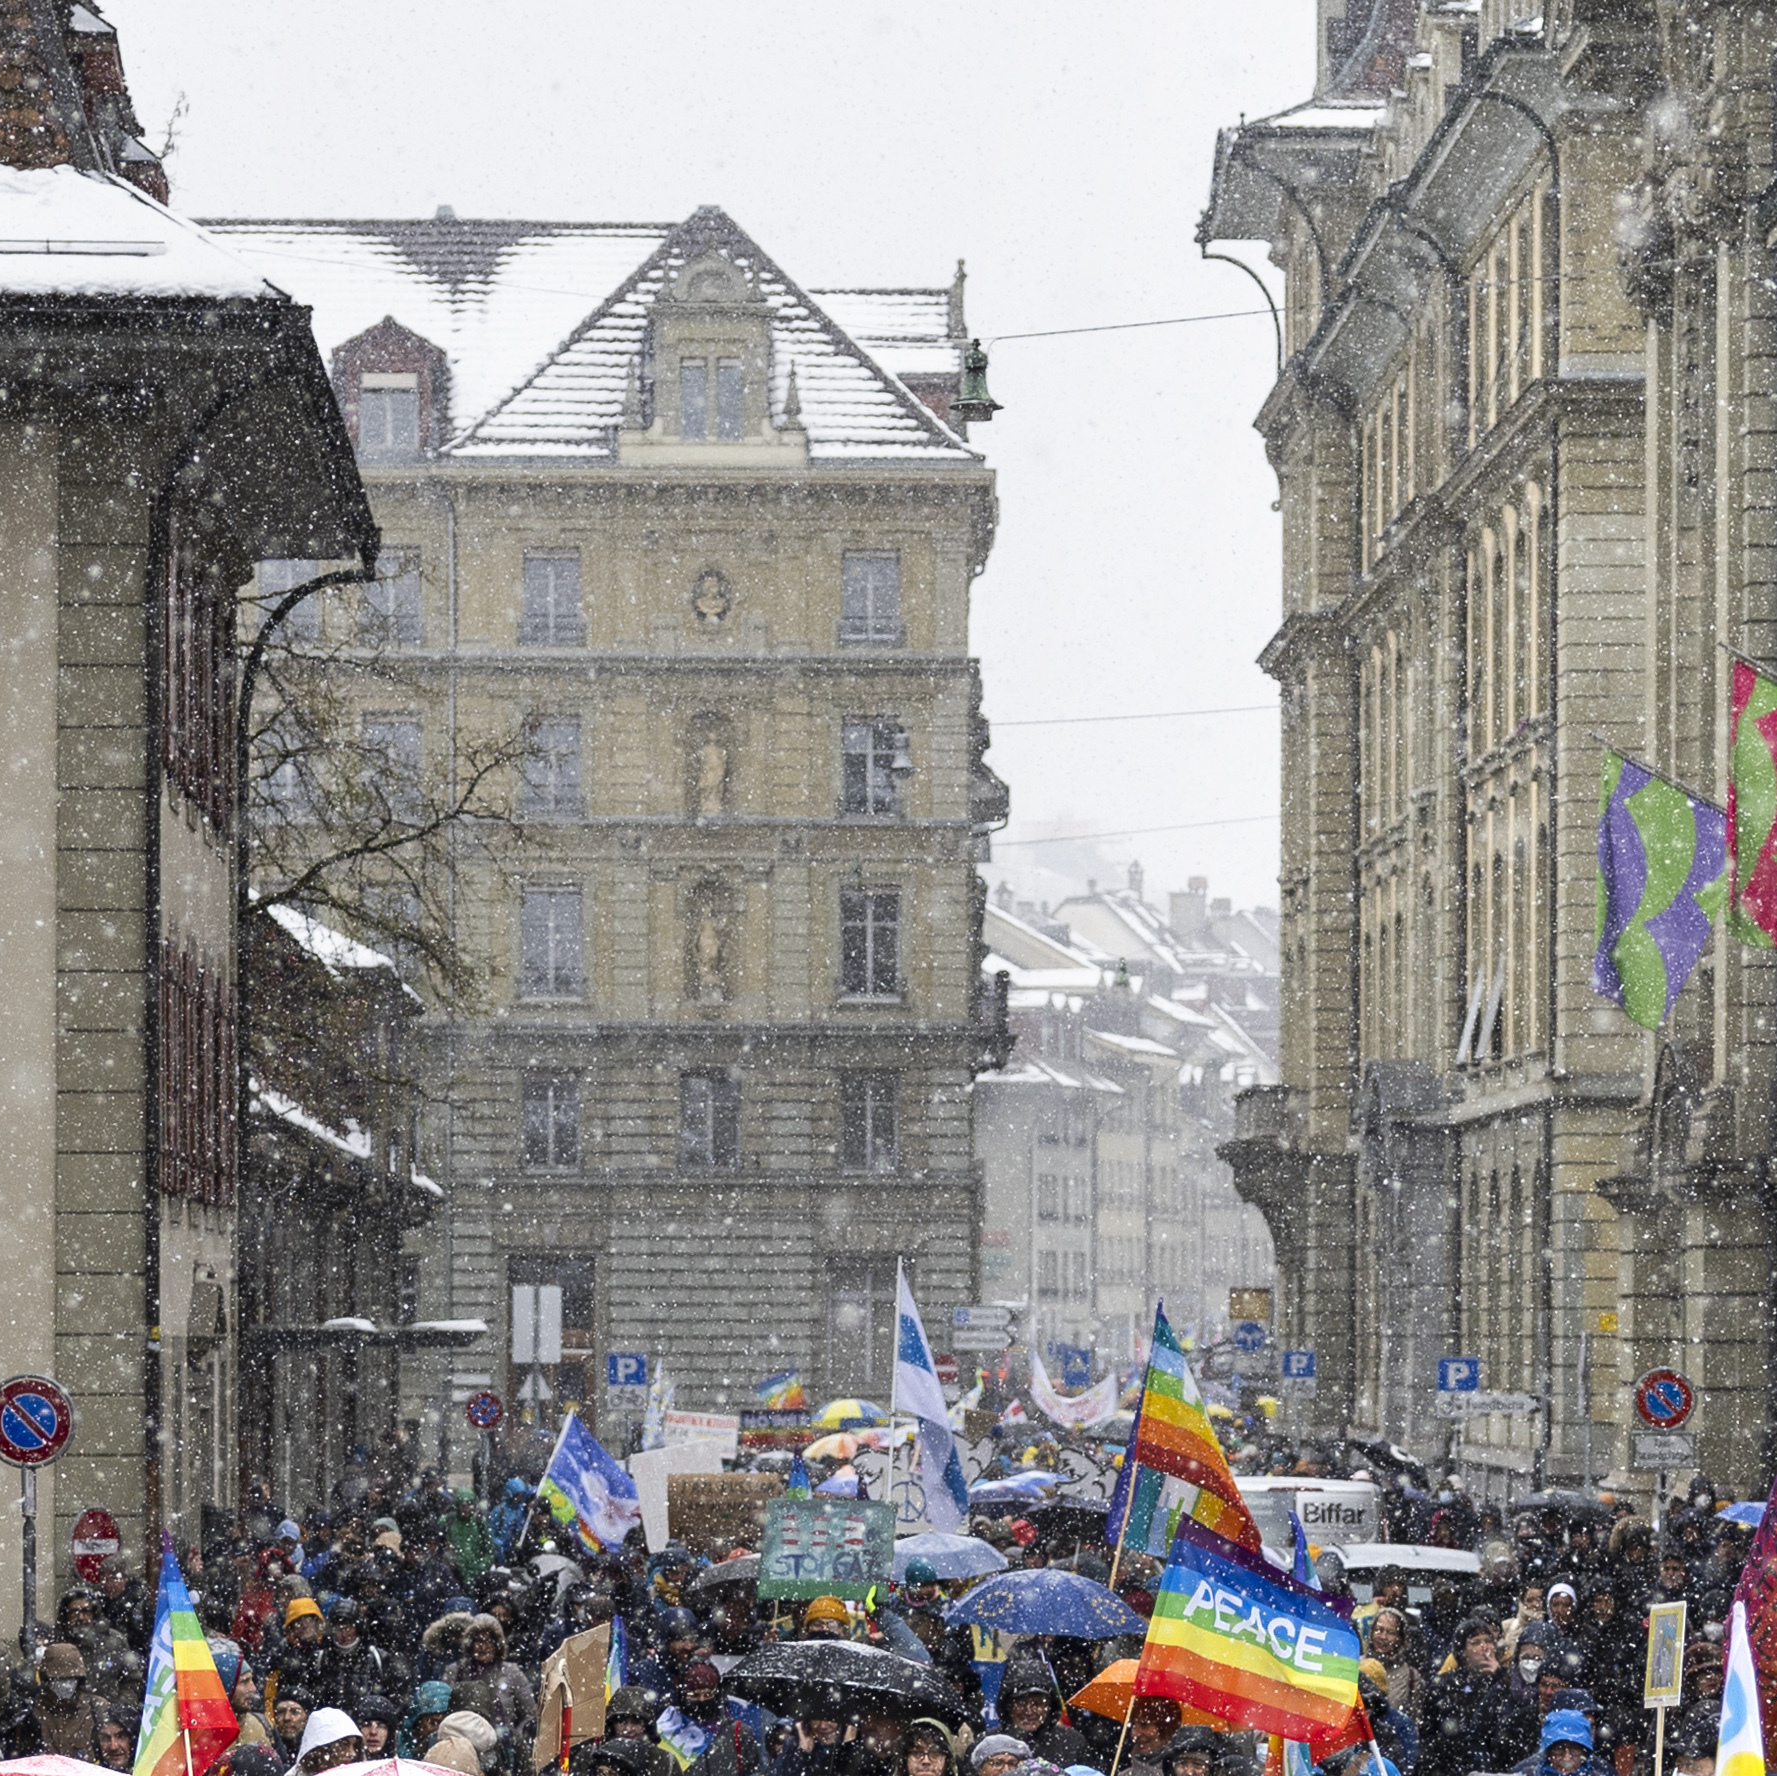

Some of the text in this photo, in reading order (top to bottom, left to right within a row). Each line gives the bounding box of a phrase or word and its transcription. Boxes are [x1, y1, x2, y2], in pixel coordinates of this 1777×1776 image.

[618, 1359, 638, 1382] P
[1289, 1354, 1307, 1374] P
[1448, 1363, 1470, 1388] P
[1303, 1502, 1367, 1525] Biffar
[1183, 1580, 1328, 1672] PEACE
